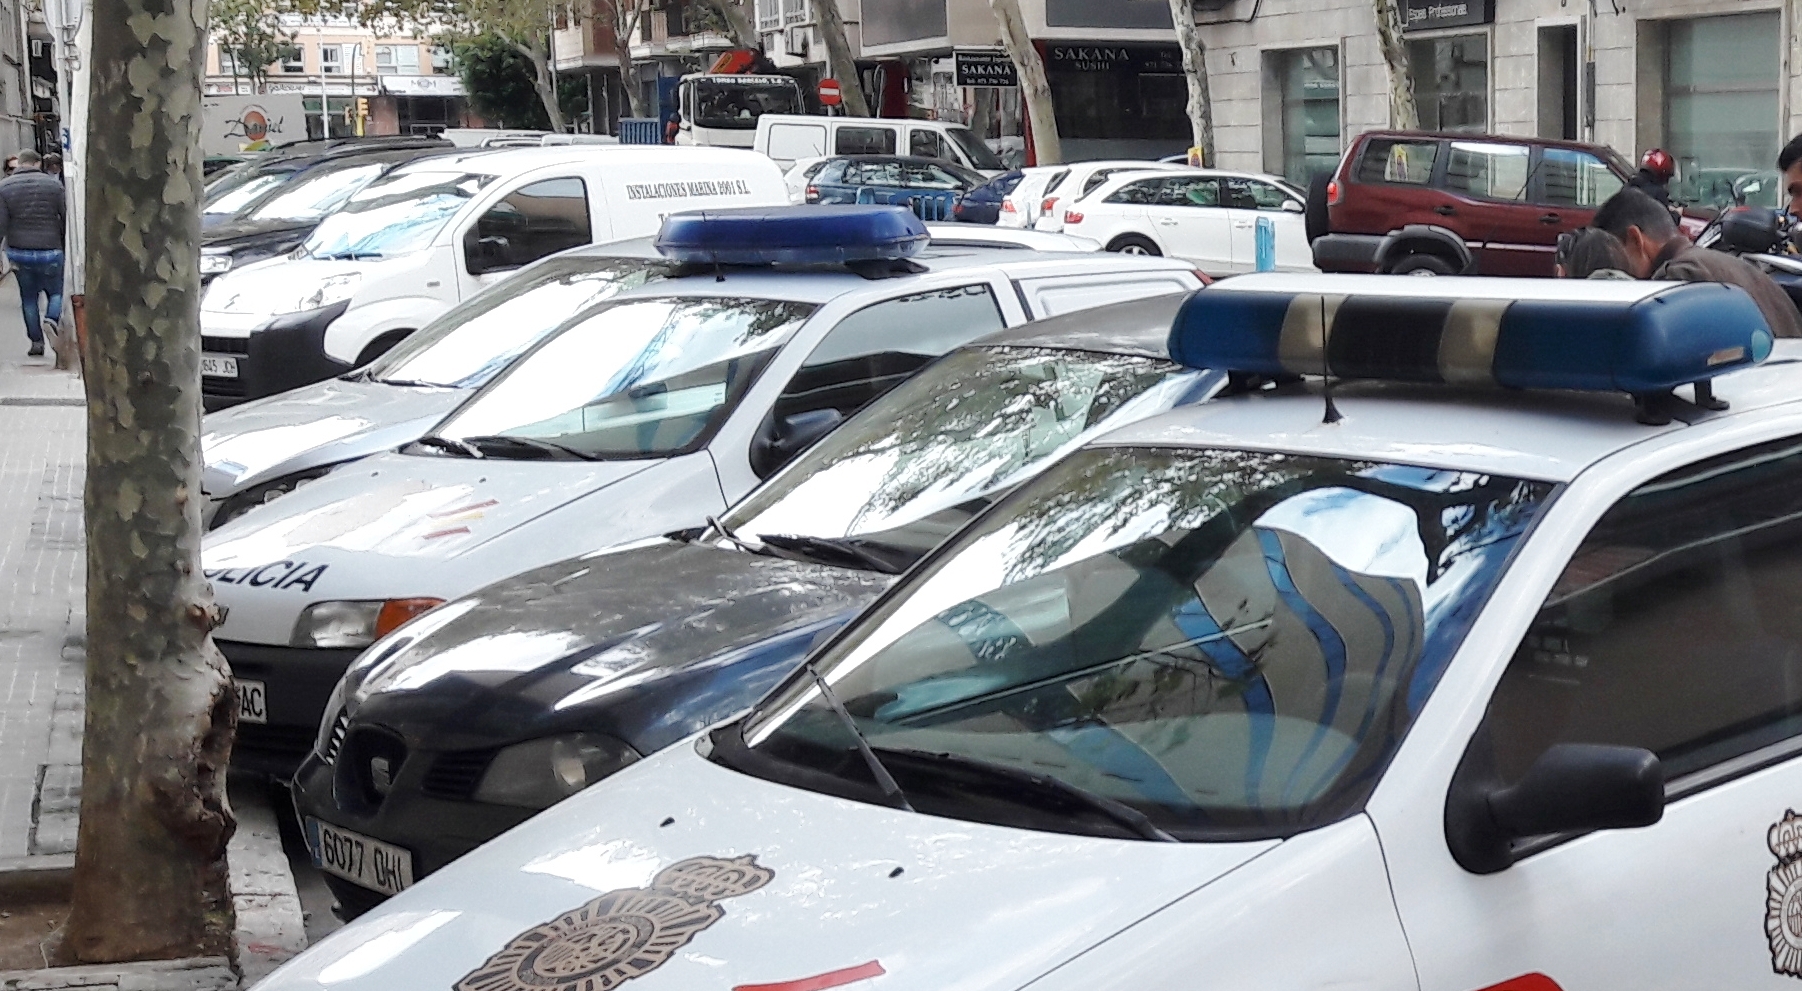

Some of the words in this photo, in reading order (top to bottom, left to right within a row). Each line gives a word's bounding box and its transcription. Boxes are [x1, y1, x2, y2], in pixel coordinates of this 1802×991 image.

[1054, 47, 1130, 61] SAKANA
[961, 64, 1011, 76] SAKANA
[626, 183, 688, 199] INSTALACIONES
[686, 181, 718, 196] MARINA
[323, 829, 365, 878] 6077
